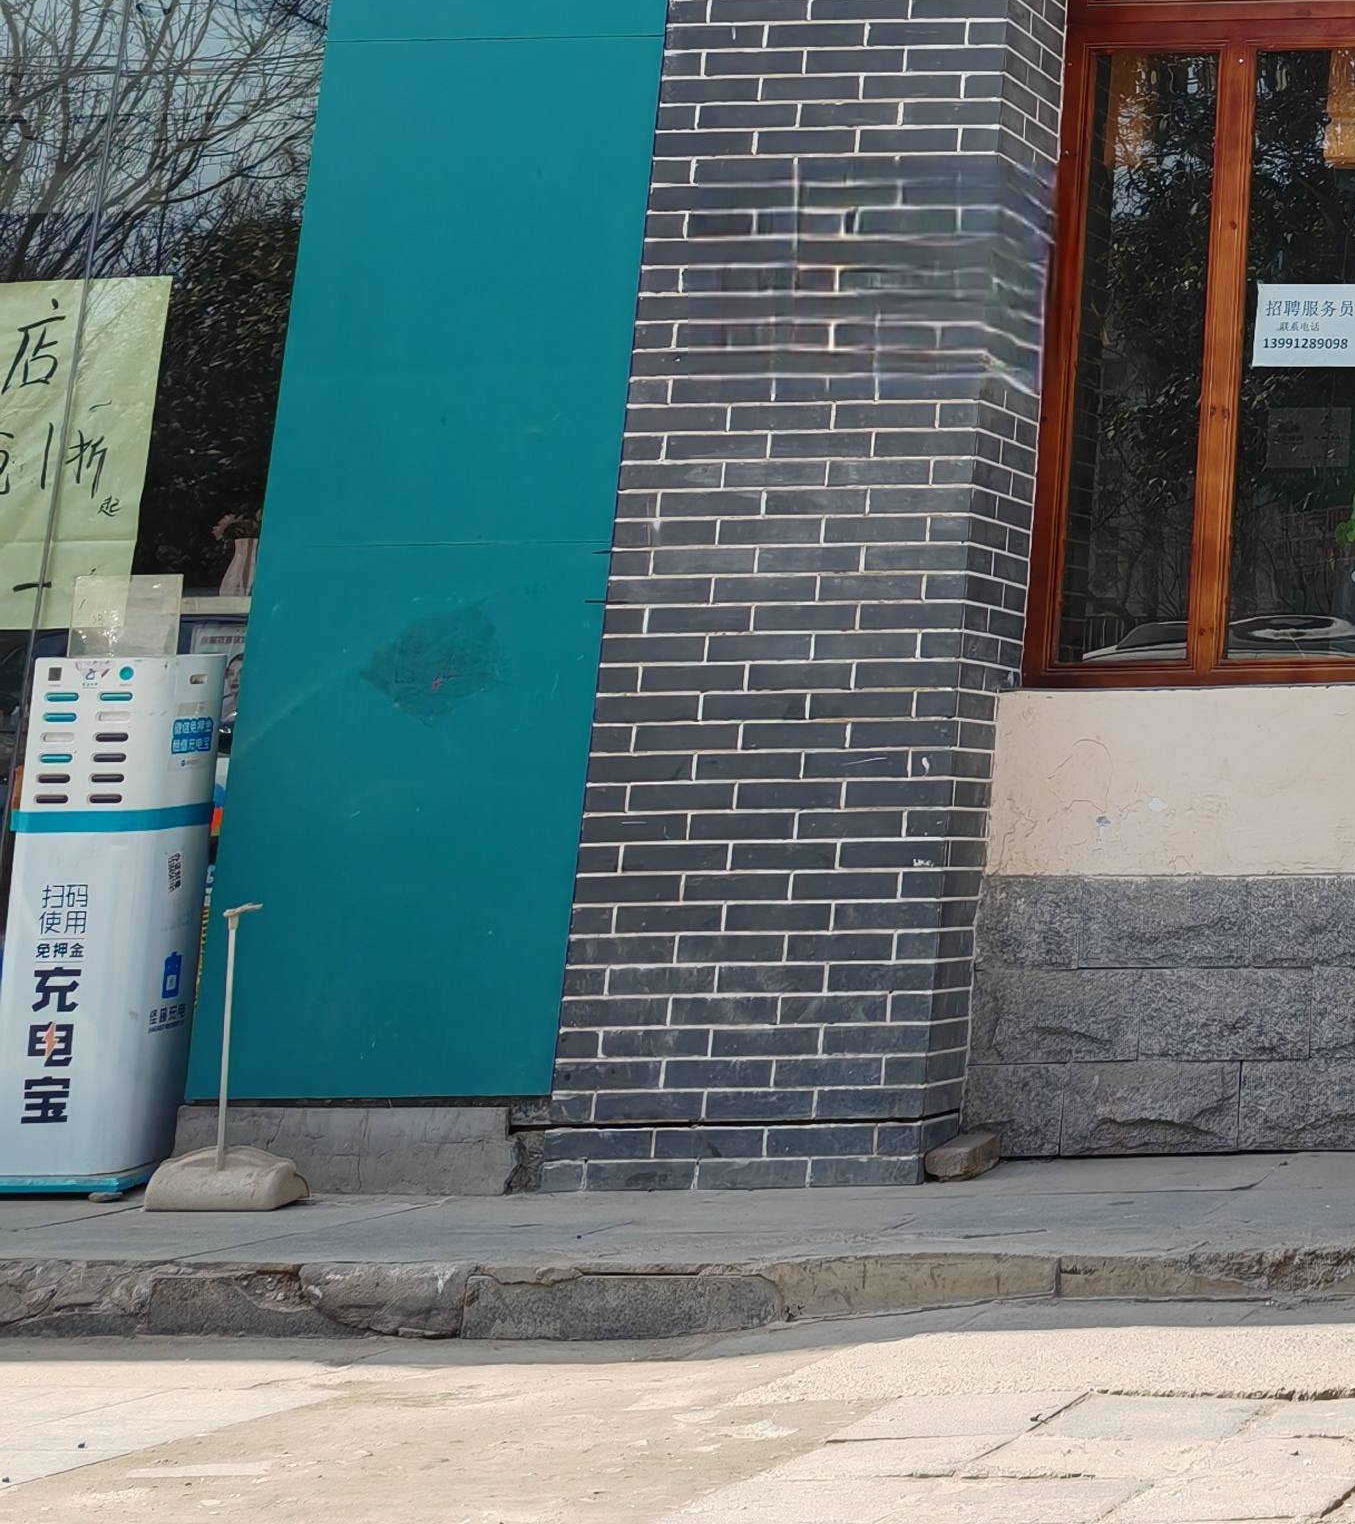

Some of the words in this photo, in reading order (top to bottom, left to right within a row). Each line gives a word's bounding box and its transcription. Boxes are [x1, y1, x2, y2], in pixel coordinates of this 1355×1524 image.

[1265, 300, 1355, 318] 招聘服务员
[1, 298, 66, 394] 店
[1262, 337, 1349, 349] 13991289098
[42, 884, 89, 908] 扫码
[39, 910, 87, 934] 使用
[35, 942, 85, 958] 免押金
[21, 967, 82, 1124] 充电宝
